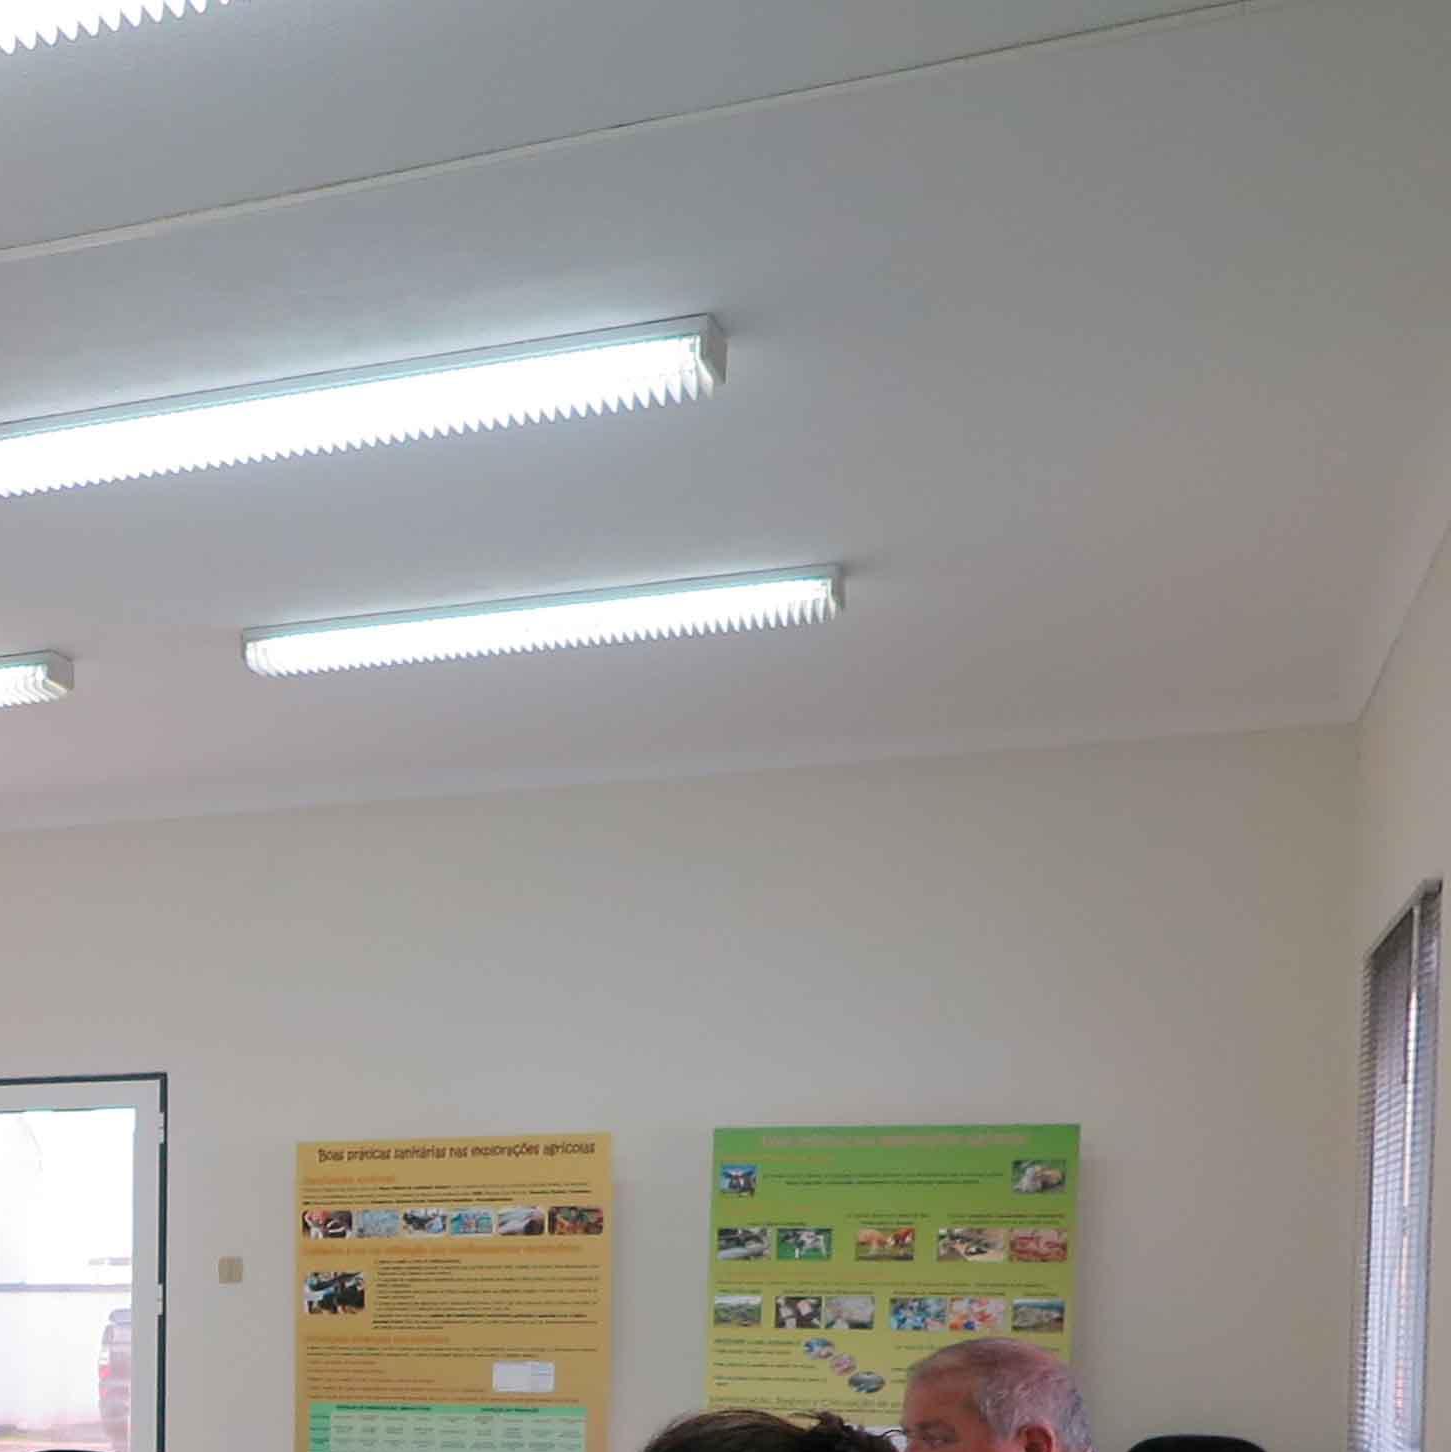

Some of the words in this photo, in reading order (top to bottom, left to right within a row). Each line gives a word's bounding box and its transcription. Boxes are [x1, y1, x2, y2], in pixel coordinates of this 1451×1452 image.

[318, 1148, 344, 1162] Boas
[395, 1145, 446, 1160] sanitárias
[471, 1142, 539, 1158] explorações
